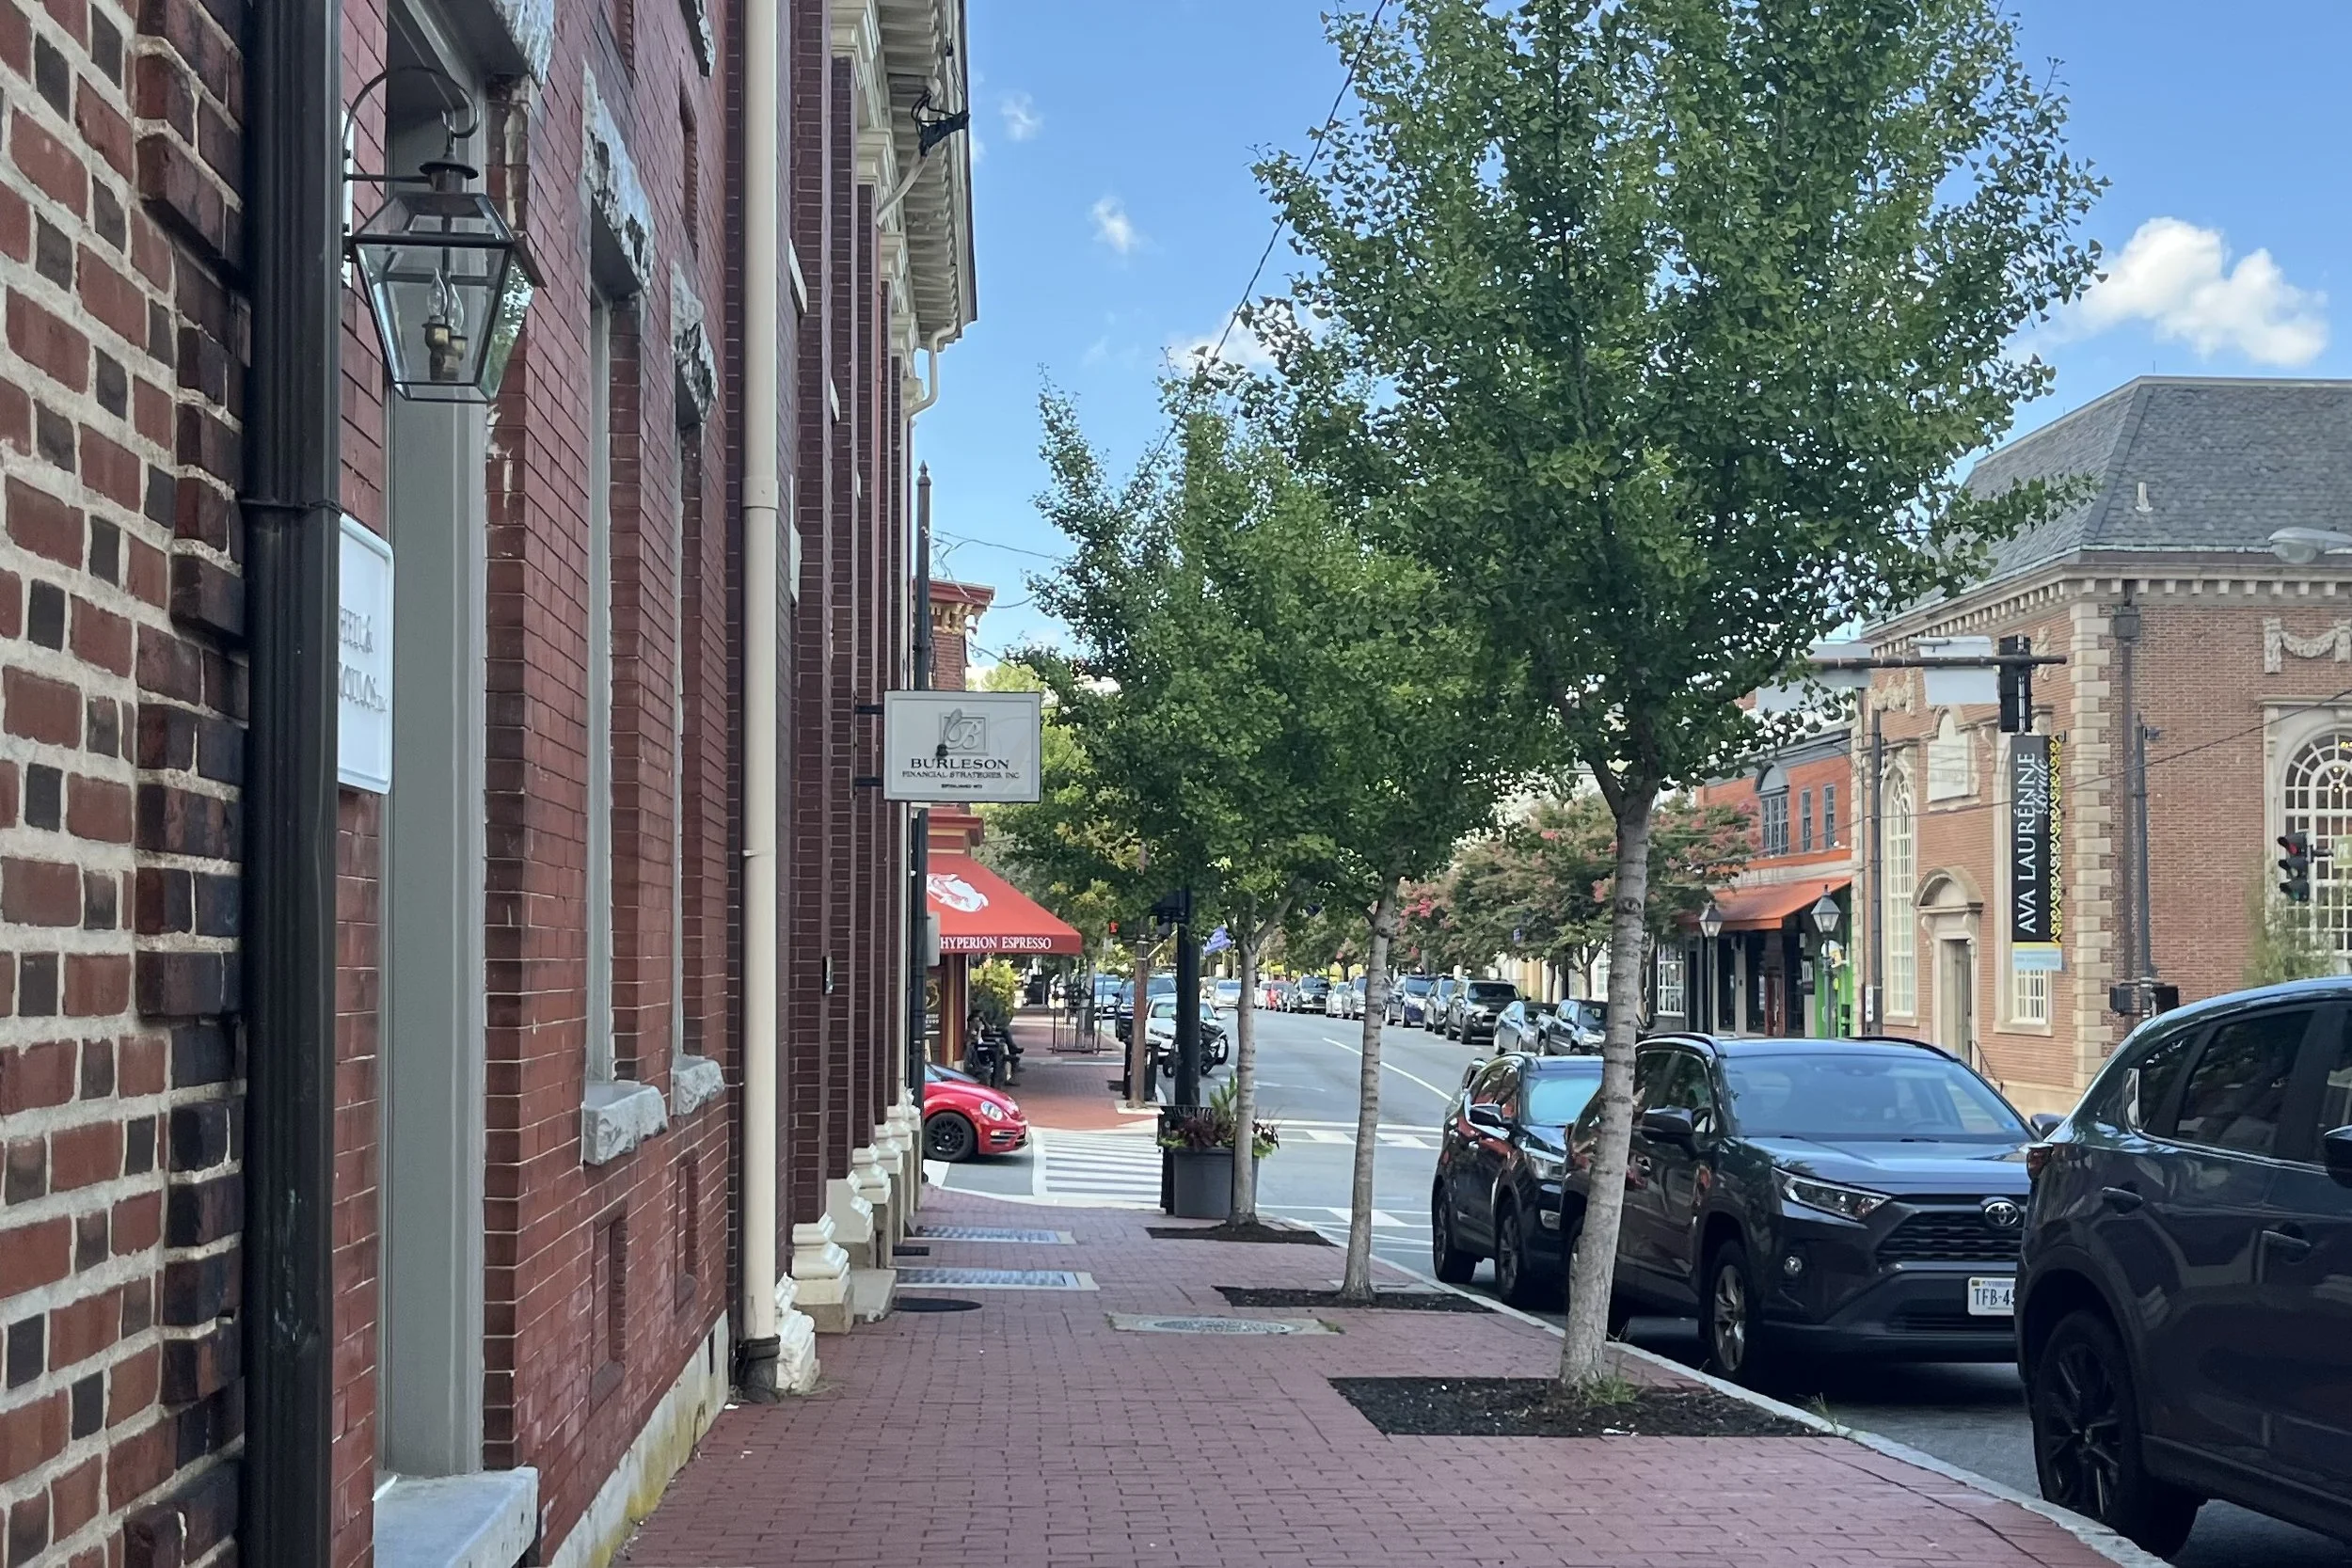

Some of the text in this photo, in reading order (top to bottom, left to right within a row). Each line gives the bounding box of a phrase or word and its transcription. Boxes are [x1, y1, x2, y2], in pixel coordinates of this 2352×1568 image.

[902, 770, 947, 779] FINANCIAL
[949, 770, 1002, 779] STRATEGIES
[911, 758, 1009, 769] BURLESON
[2030, 757, 2050, 815] Bride
[2013, 752, 2037, 881] LAURÉNNE
[2018, 887, 2037, 933] AVA
[940, 936, 1052, 950] HYPERION ESPRESSO
